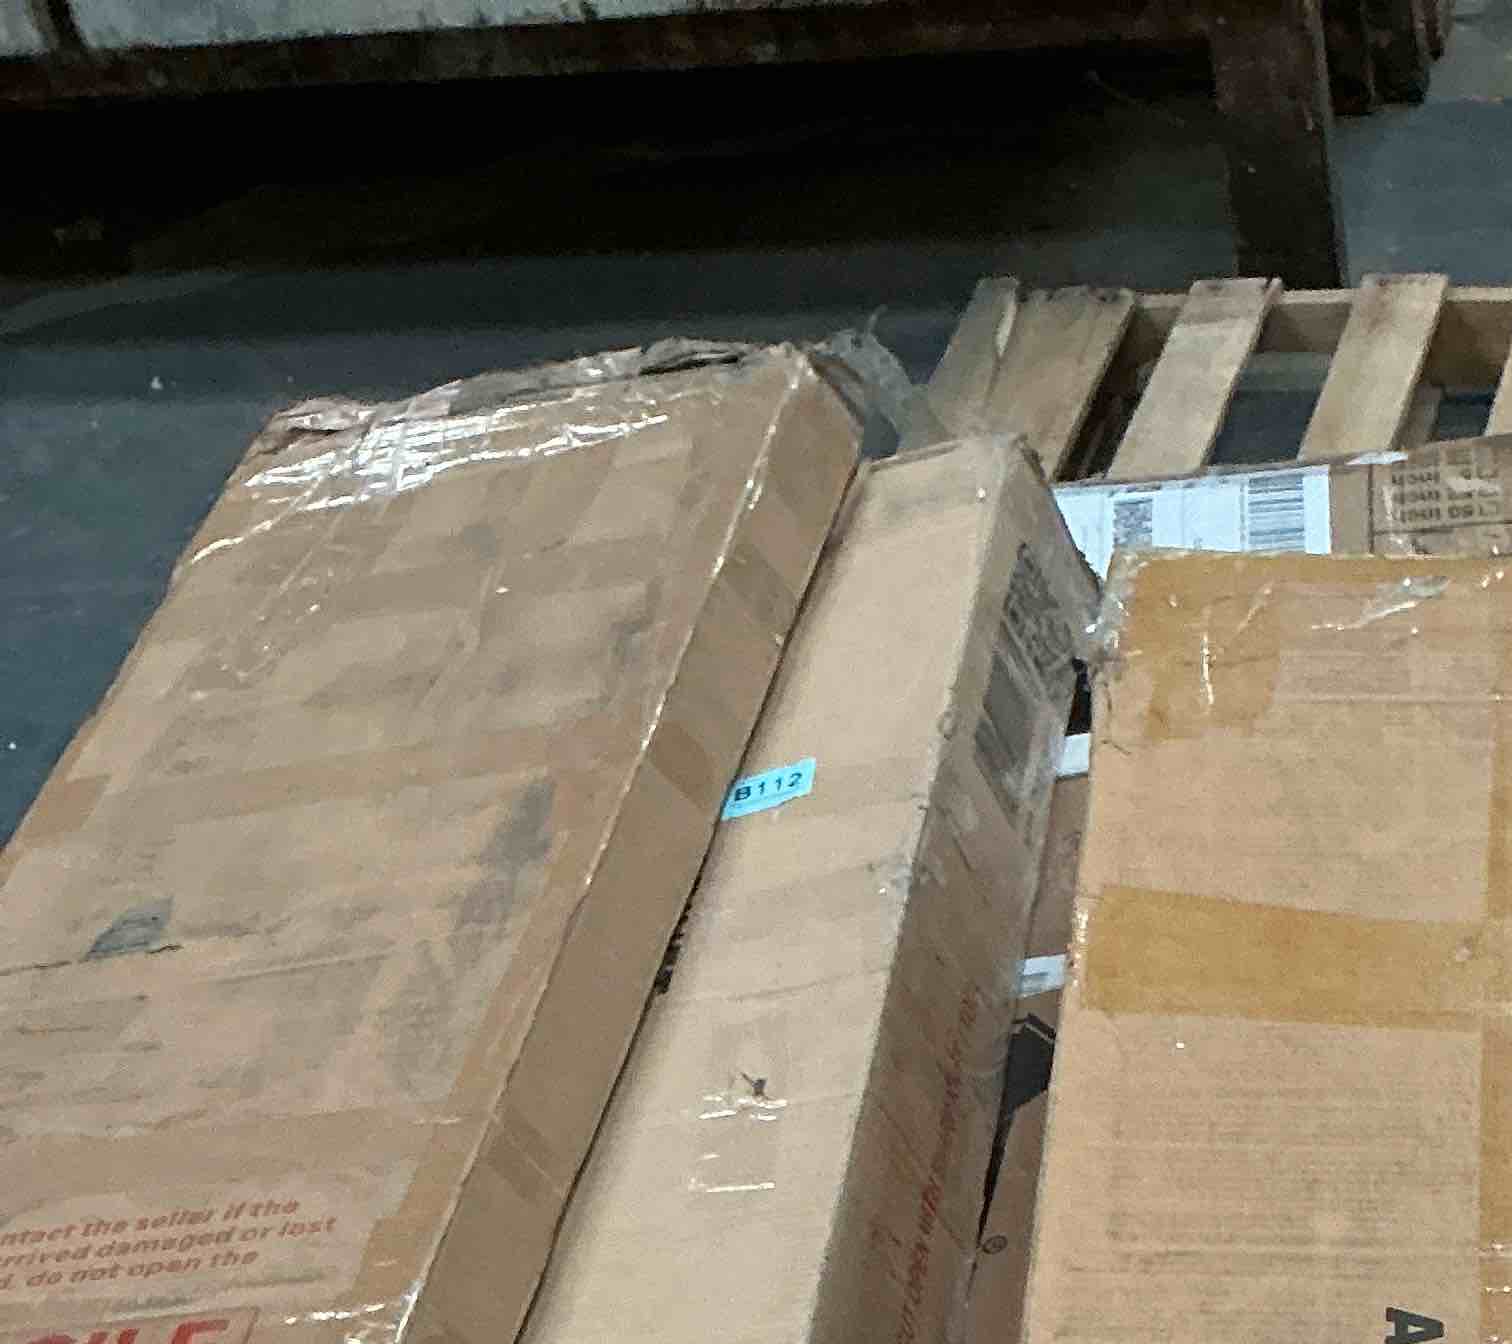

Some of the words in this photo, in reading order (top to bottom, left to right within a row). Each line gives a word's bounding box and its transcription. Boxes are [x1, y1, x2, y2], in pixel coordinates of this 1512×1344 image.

[734, 771, 803, 803] B112
[95, 1225, 235, 1260] damaged
[238, 1227, 275, 1243] or
[69, 1262, 122, 1284] not
[127, 1255, 203, 1280] open
